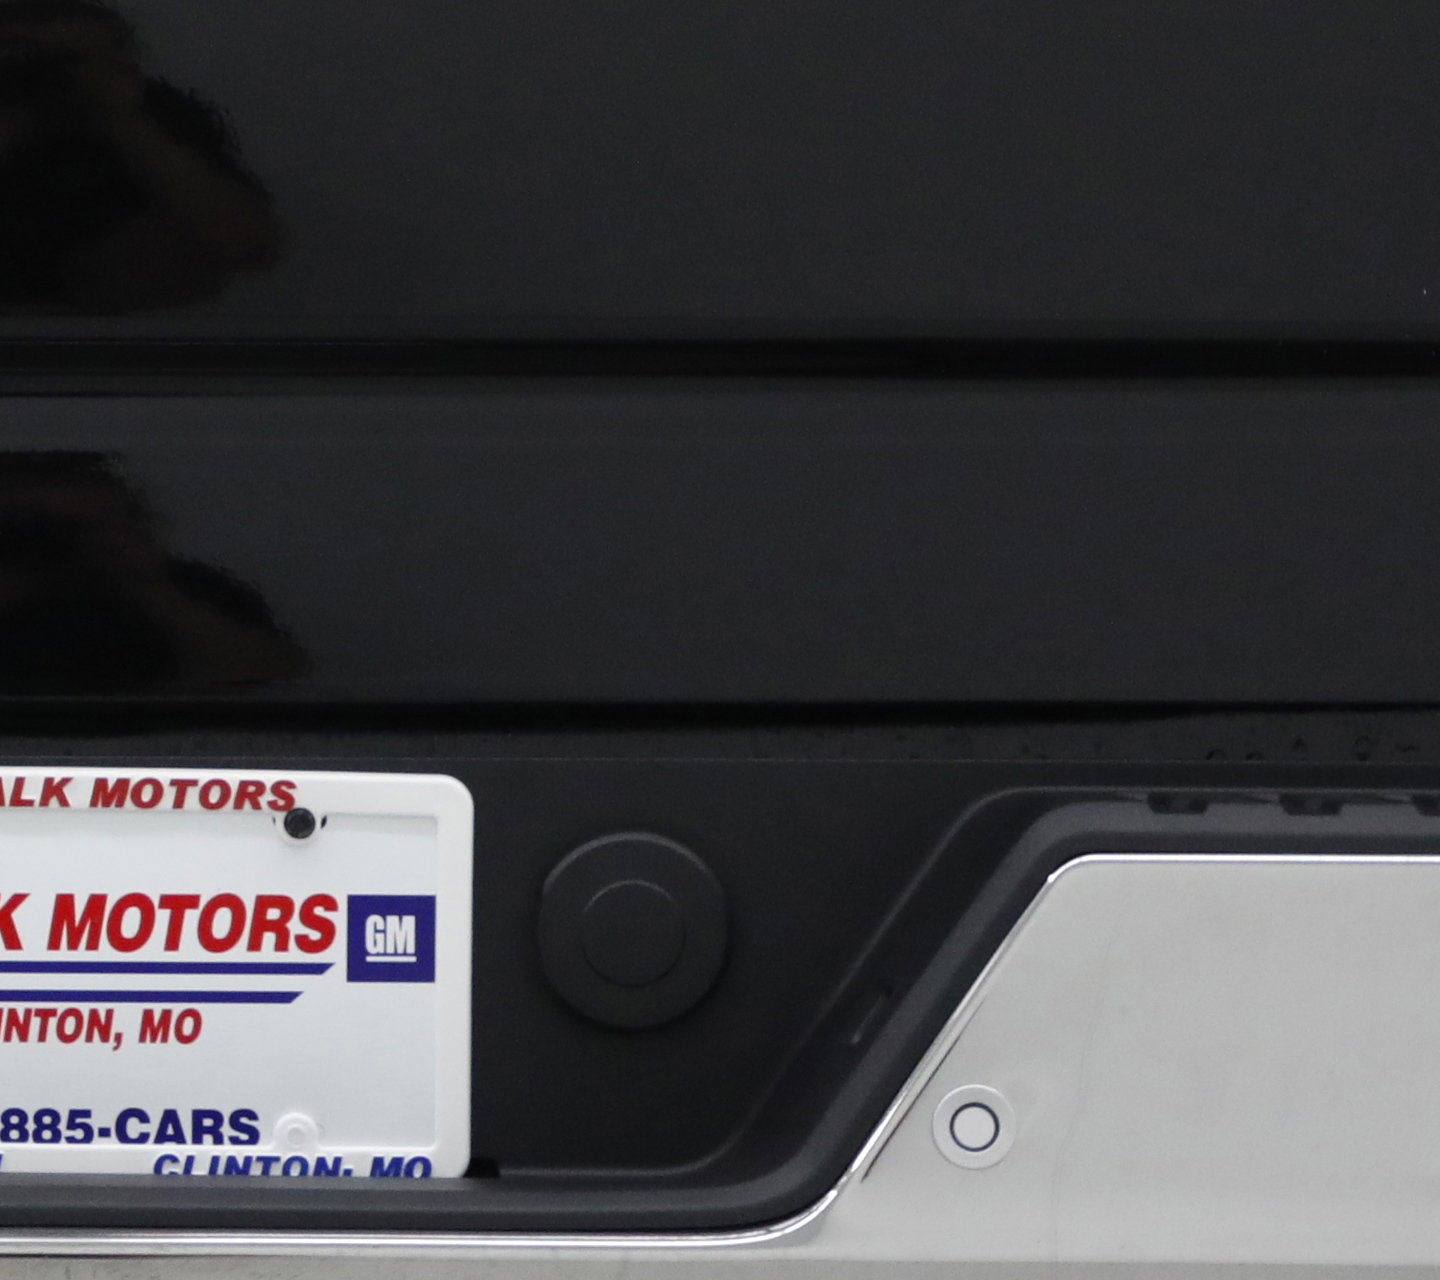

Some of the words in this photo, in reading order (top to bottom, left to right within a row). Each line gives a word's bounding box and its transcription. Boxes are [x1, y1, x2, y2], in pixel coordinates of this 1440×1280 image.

[91, 778, 295, 811] MOTORS
[48, 892, 338, 954] MOTORS
[365, 915, 416, 954] GM
[140, 1008, 202, 1044] MO
[371, 1156, 432, 1178] MO
